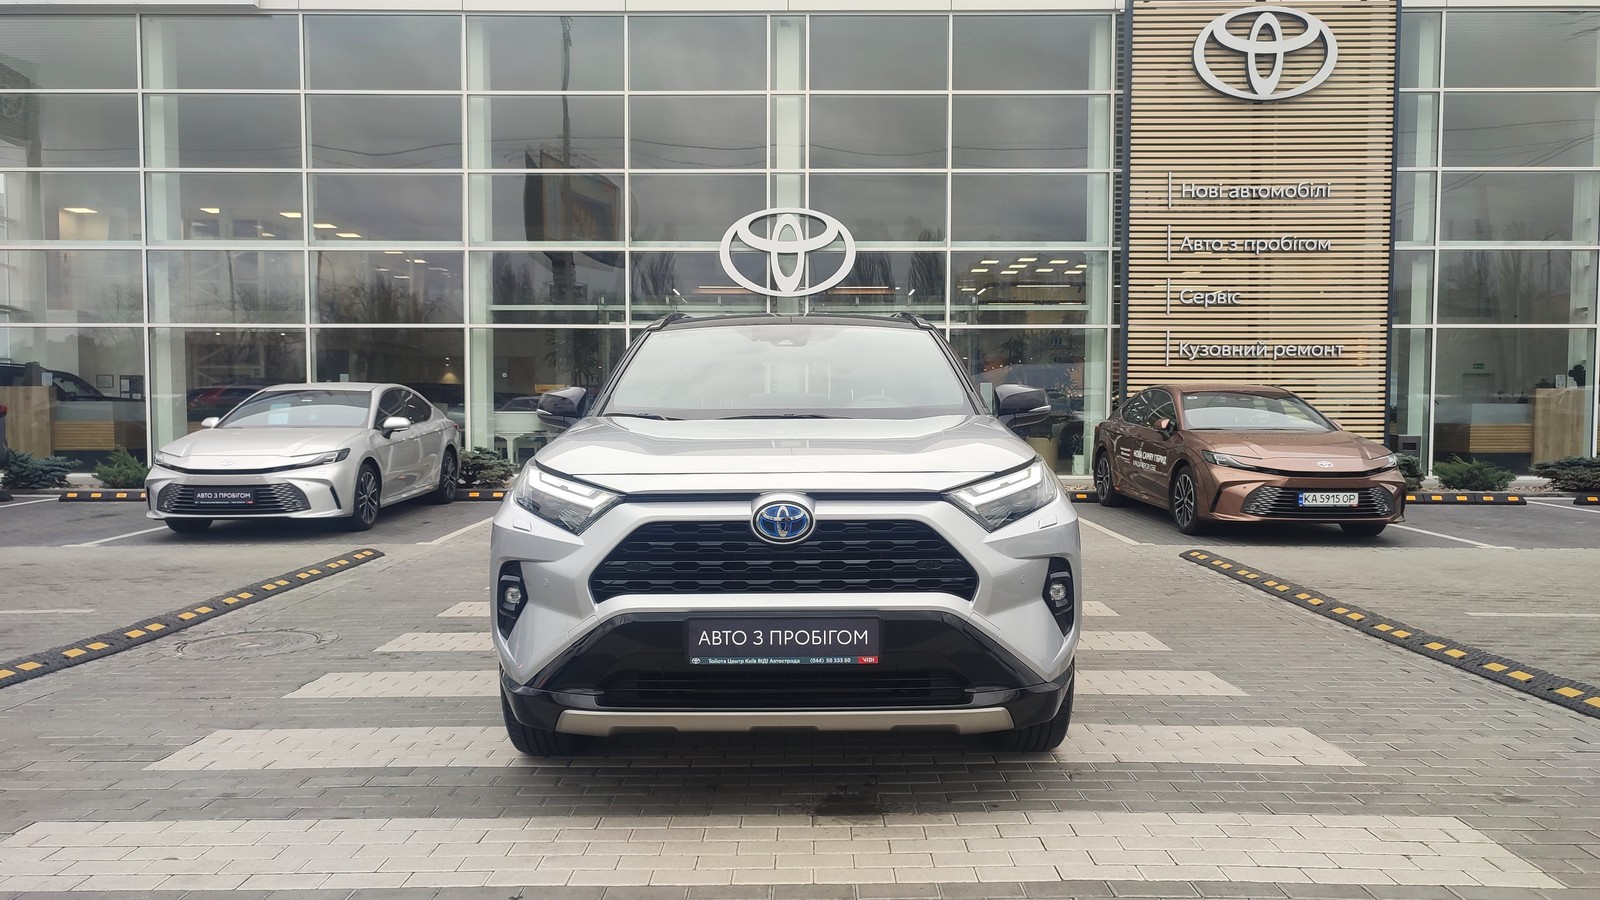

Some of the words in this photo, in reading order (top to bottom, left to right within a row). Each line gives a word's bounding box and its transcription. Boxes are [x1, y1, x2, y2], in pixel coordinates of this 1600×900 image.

[1181, 182, 1223, 198] Нові
[1228, 182, 1331, 198] автомобілі
[1180, 236, 1223, 251] Авто
[1228, 238, 1238, 251] з
[1244, 235, 1332, 255] пробігом
[1179, 289, 1242, 308] Сервіс
[1179, 341, 1267, 361] Кузовний
[1273, 343, 1345, 361] ремонт
[1320, 494, 1341, 504] 5915
[698, 630, 748, 646] АВТО
[752, 630, 764, 646] З
[769, 629, 869, 646] ПРОБІГОМ
